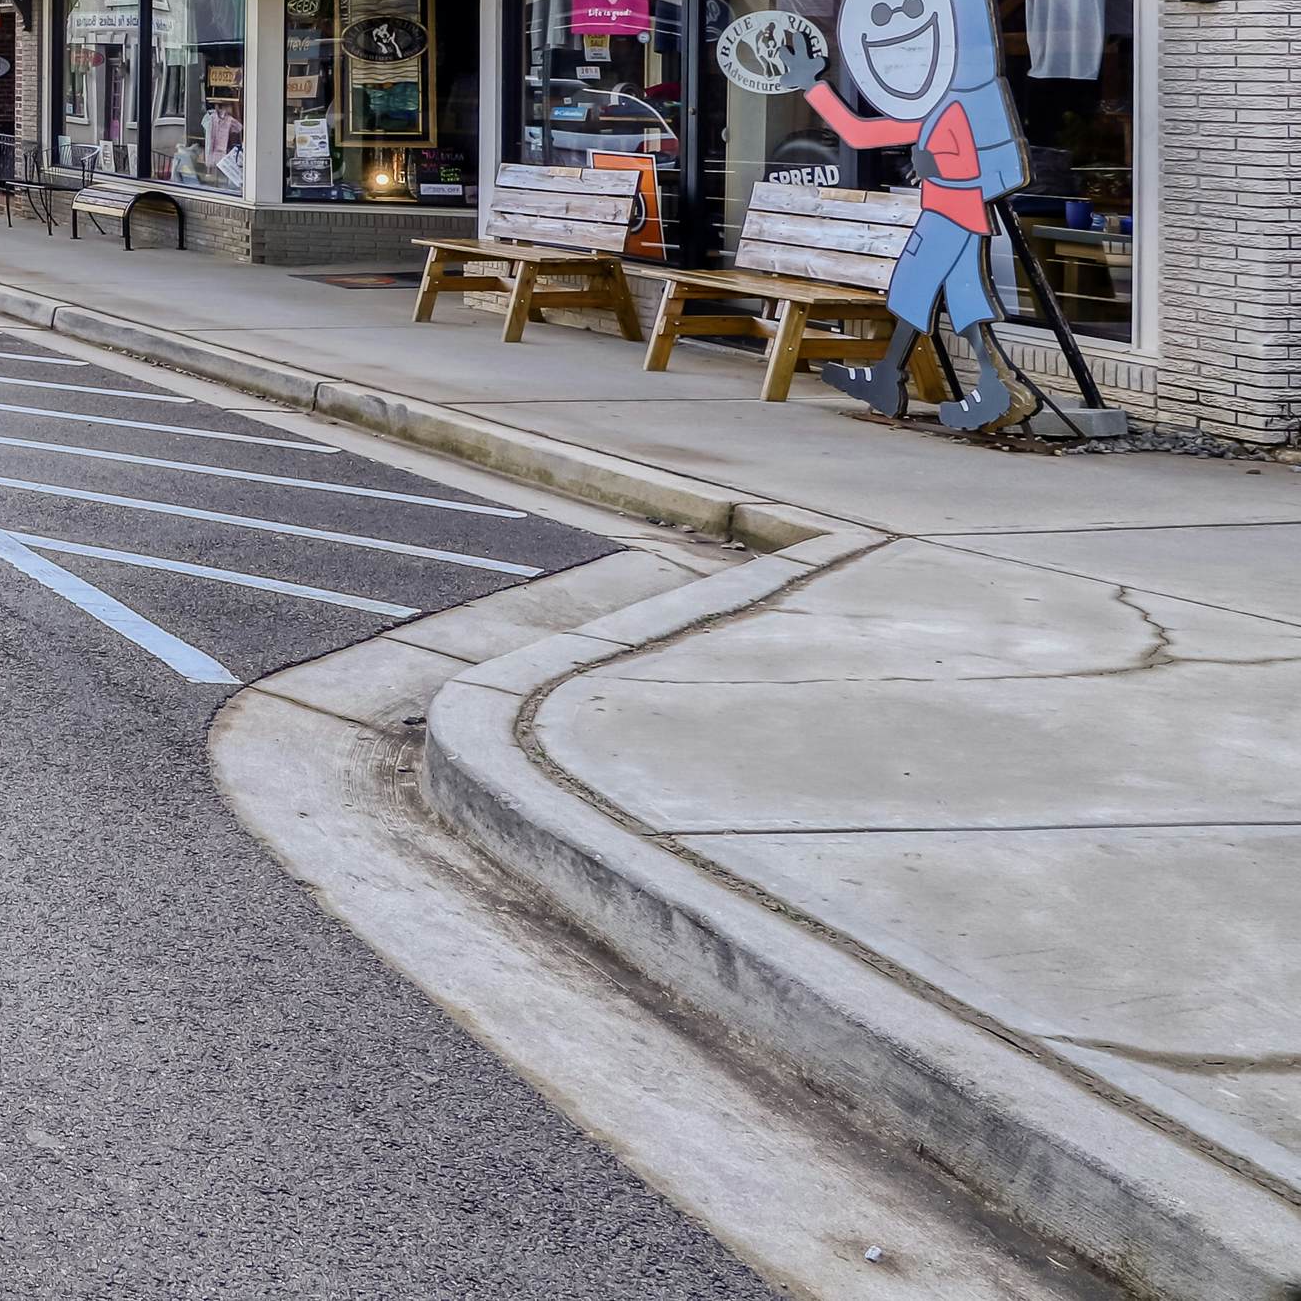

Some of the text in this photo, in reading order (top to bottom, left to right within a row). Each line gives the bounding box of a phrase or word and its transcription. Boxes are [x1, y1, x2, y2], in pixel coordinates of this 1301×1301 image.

[287, 0, 319, 13] KEEN
[588, 9, 602, 17] Life
[720, 16, 753, 57] BLUE
[723, 60, 781, 92] Adventure
[768, 164, 840, 188] SPREAD
